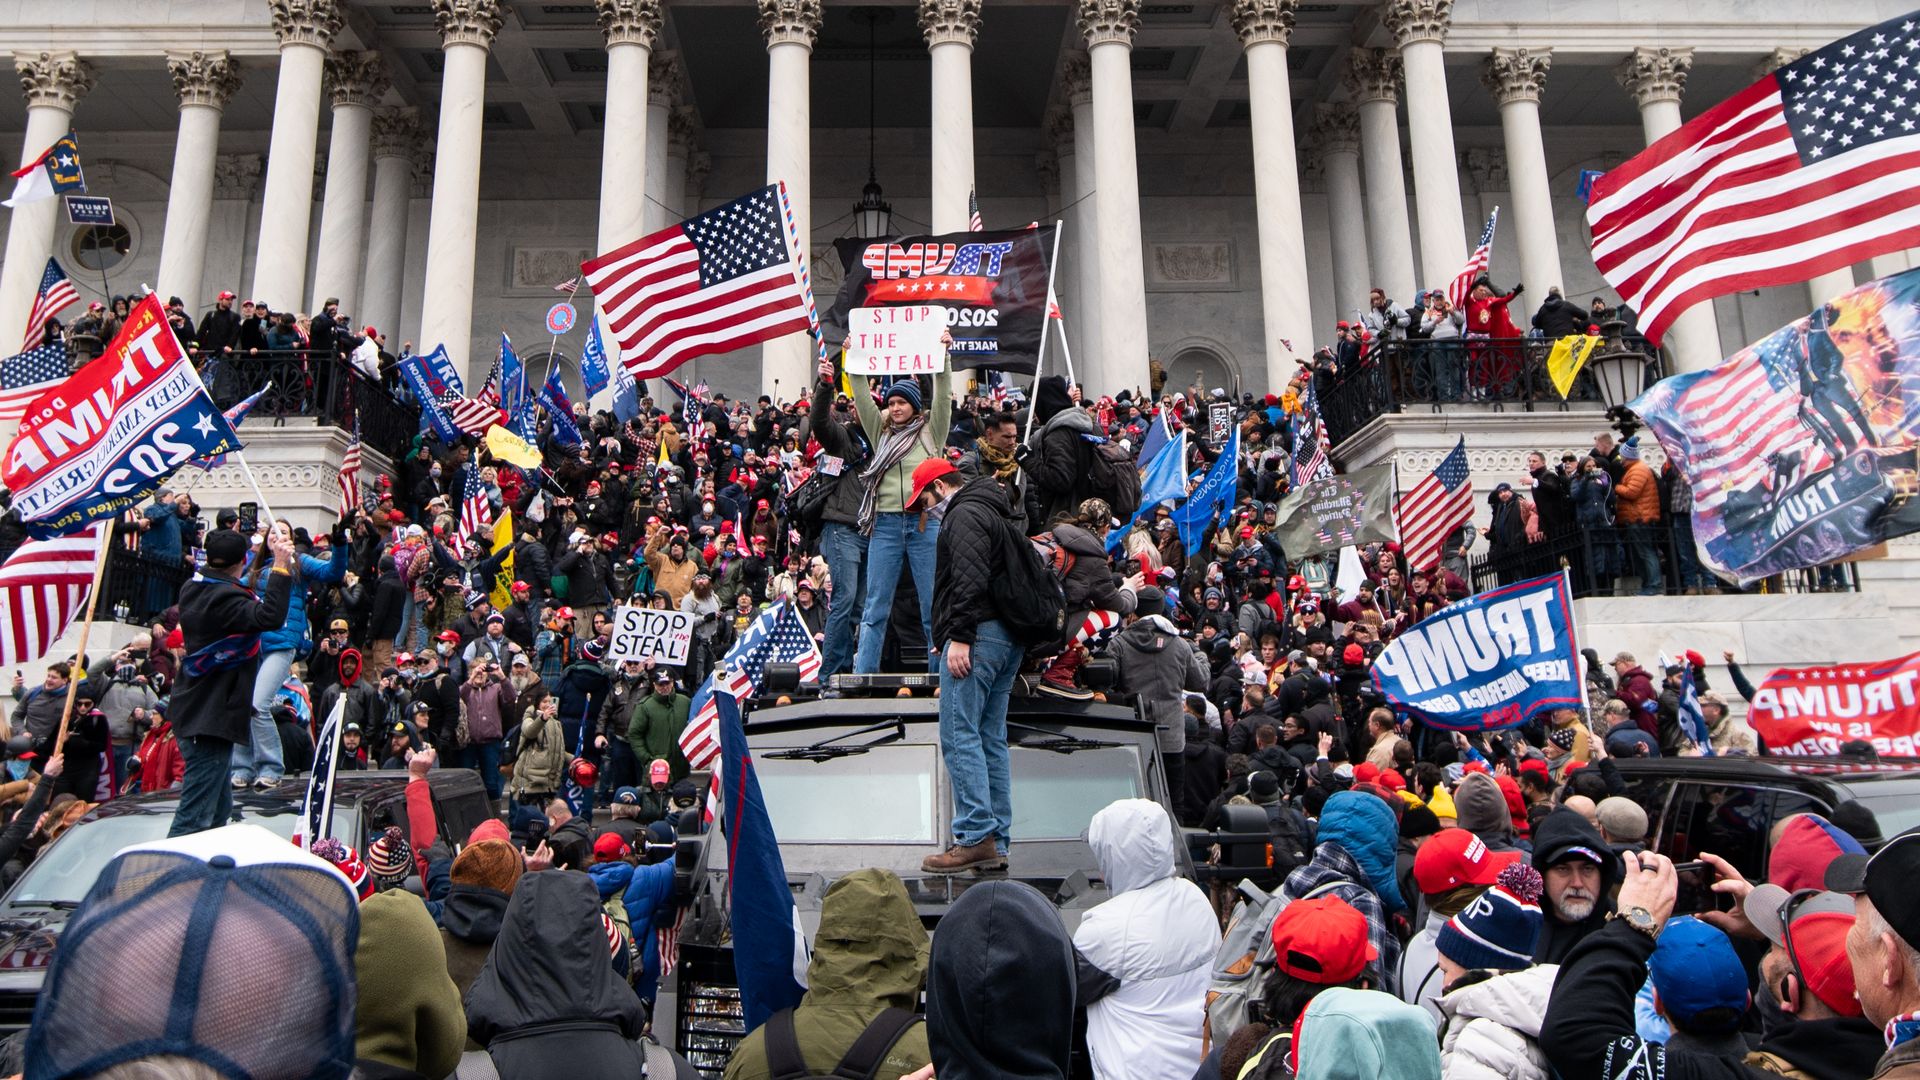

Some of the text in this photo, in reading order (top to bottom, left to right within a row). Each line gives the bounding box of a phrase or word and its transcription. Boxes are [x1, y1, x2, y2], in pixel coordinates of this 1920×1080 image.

[873, 307, 930, 324] STOP
[860, 333, 896, 349] THE
[869, 354, 934, 371] STEAL
[407, 363, 454, 435] NO MORE BULLSHIT
[1220, 408, 1228, 436] FUCK
[623, 610, 687, 638] STOP
[614, 633, 687, 661] STEAL!
